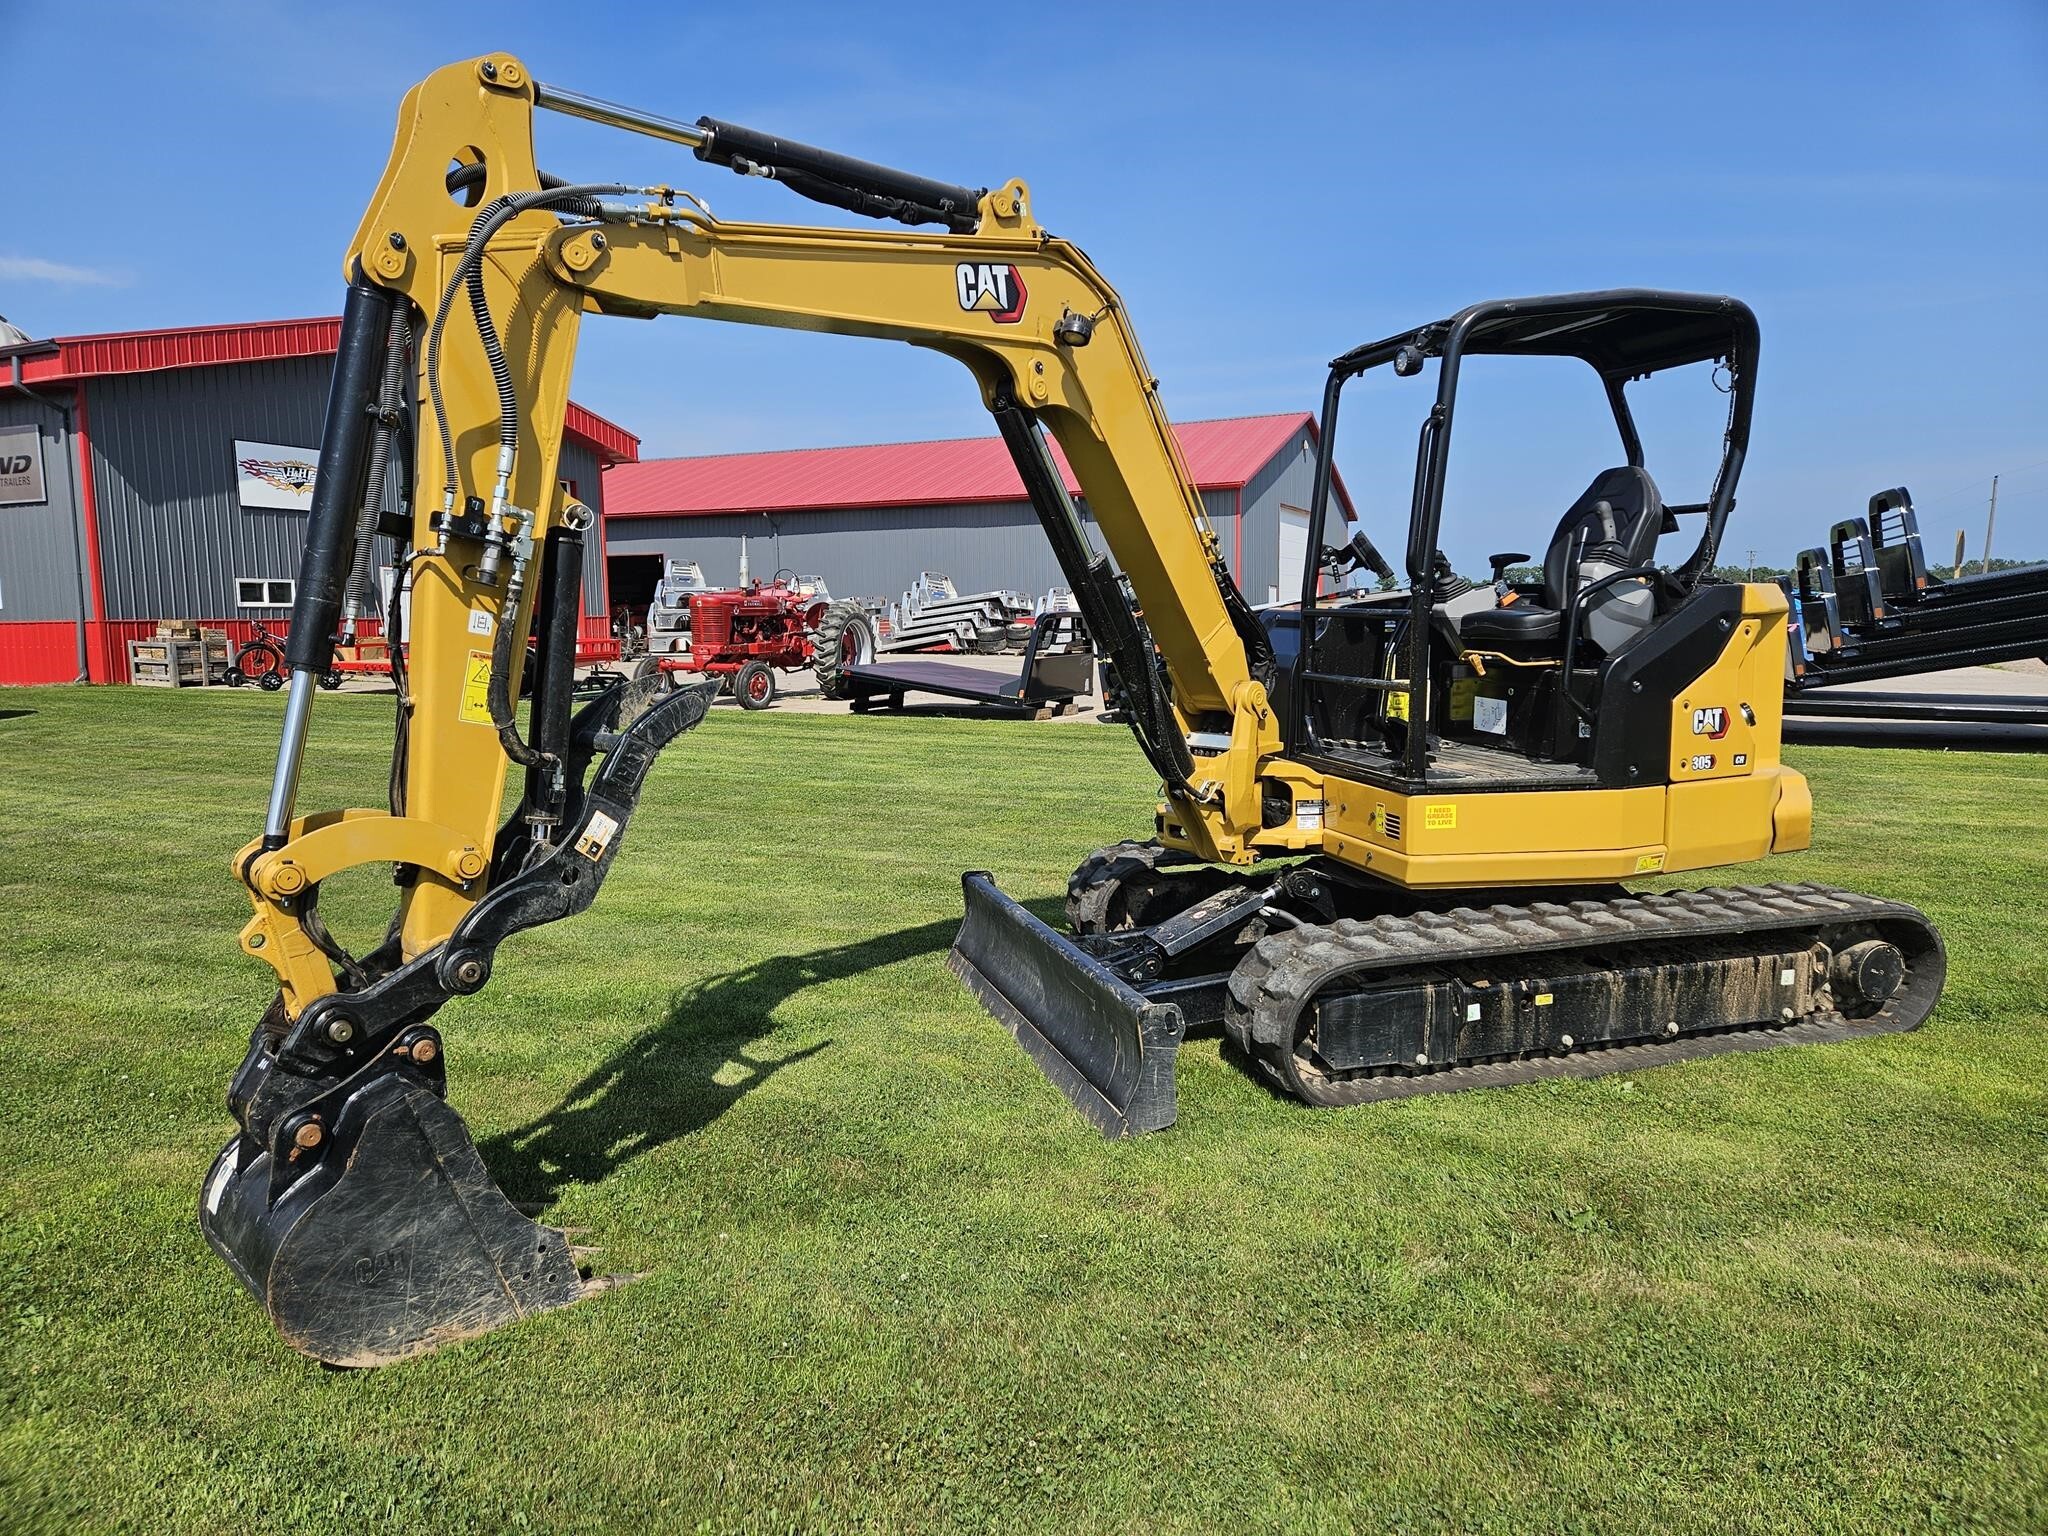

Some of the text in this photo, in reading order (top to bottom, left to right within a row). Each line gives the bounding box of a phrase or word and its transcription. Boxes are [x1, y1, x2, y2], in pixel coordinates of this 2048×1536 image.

[956, 263, 1009, 311] CAT
[0, 475, 31, 487] TRAILERS
[1693, 708, 1723, 734] CAT
[1692, 755, 1745, 770] 305 CR
